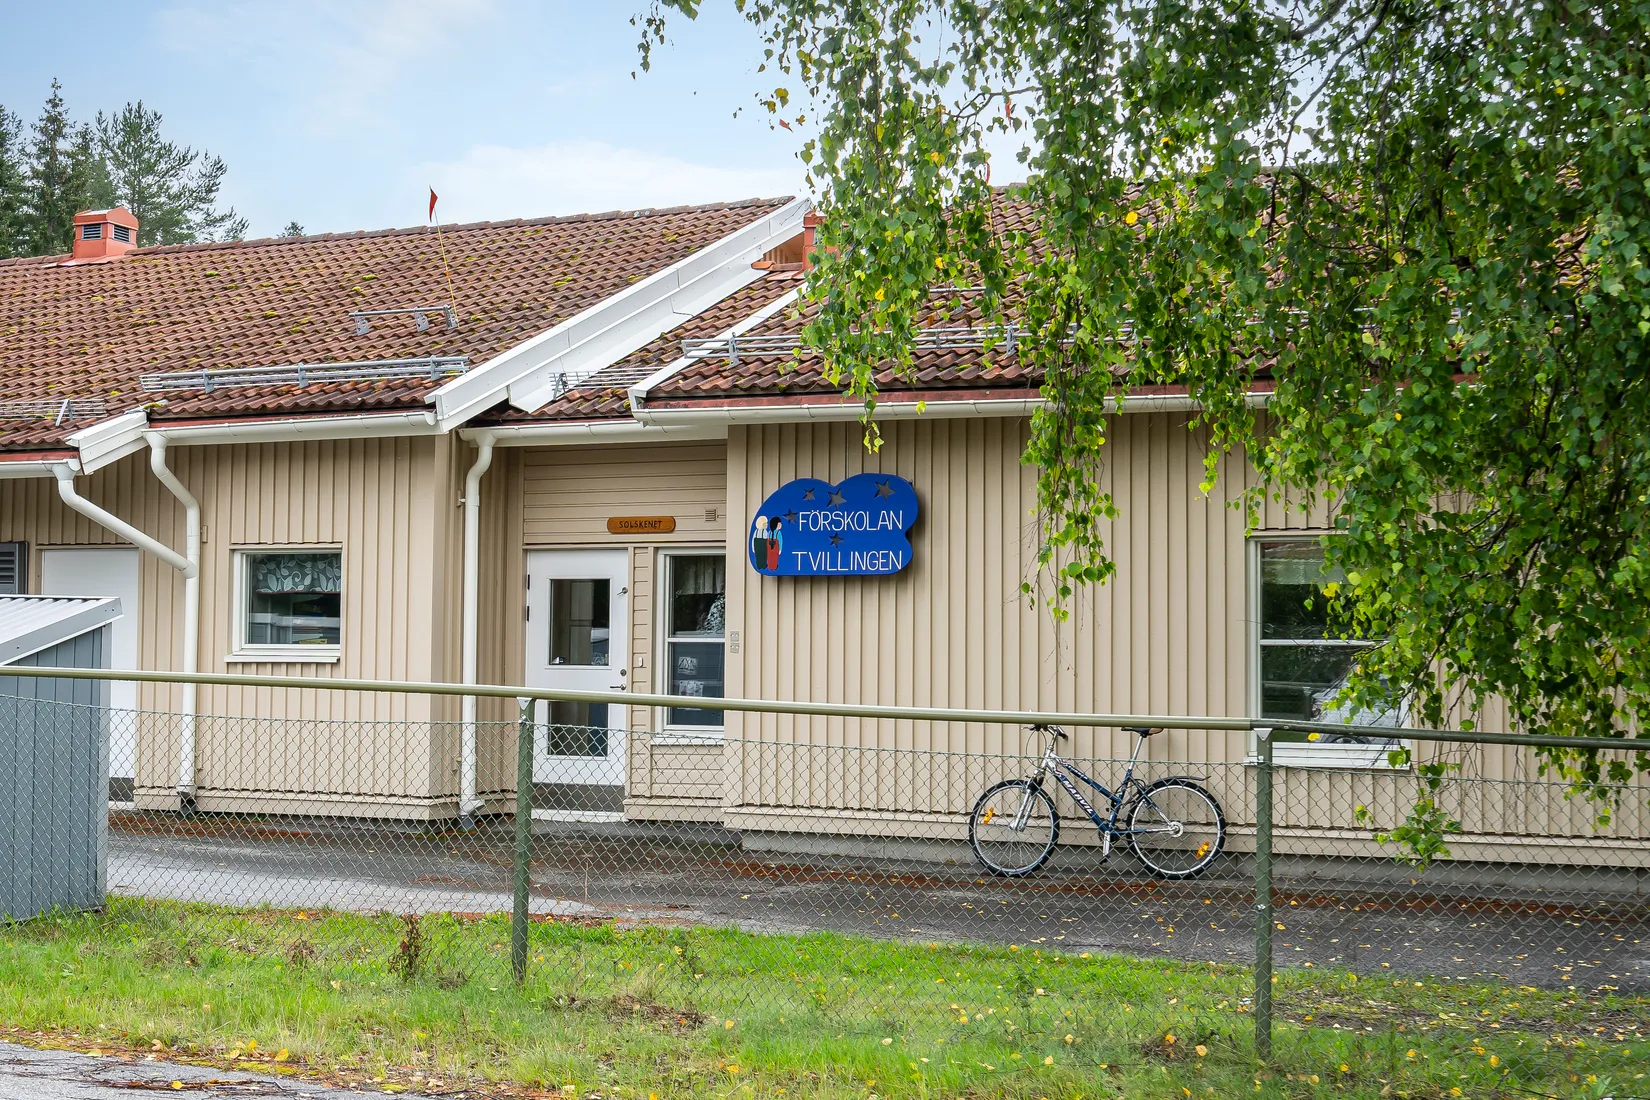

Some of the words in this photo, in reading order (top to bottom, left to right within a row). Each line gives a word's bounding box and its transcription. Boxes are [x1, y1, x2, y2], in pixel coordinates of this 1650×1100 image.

[619, 520, 662, 528] SOLSKENET
[799, 510, 902, 531] FÖRSKOLAN
[792, 550, 902, 571] TVILLINGEN
